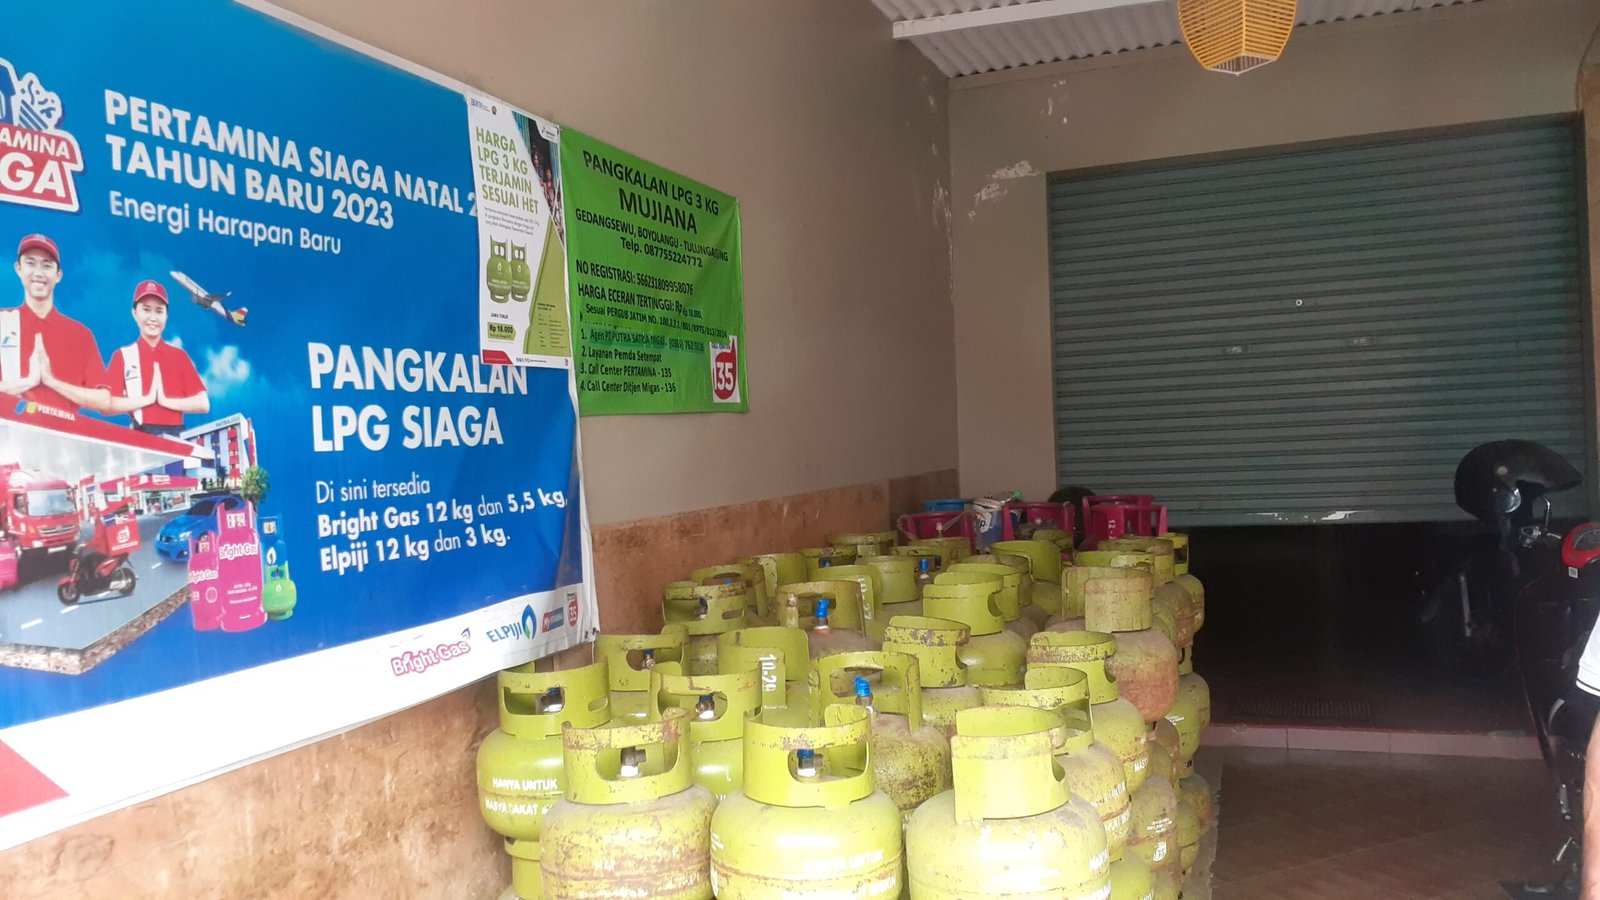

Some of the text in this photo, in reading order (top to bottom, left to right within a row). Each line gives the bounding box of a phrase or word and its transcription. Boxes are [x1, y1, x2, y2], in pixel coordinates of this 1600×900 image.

[104, 89, 302, 172] PERTAMINA
[309, 146, 388, 194] SIAGA
[394, 171, 464, 214] NATAL
[475, 126, 517, 154] HARGA
[477, 146, 528, 175] LPG 3 KG
[105, 133, 394, 230] TAHUN BARU 2023
[479, 164, 532, 195] TERJAMIN
[583, 150, 719, 216] PANGKALAN LPG 3 KG
[482, 184, 539, 214] SESUAI HET
[618, 187, 698, 234] MUJIANA
[109, 190, 341, 255] Energi Harapan Baru
[575, 208, 636, 238] GEDANGSEWU,
[637, 226, 679, 249] BOYOLANGU
[620, 237, 703, 268] Telp. 087755224772
[576, 259, 589, 274] NO
[590, 263, 636, 284] REGISTRASI:
[578, 282, 607, 301] HARGA
[608, 288, 636, 306] ECERAN
[636, 293, 675, 312] TERTINGGI:
[585, 303, 606, 316] Sesuai
[606, 306, 629, 320] PERGUB
[629, 311, 647, 323] JATIM
[580, 329, 587, 340] 1.
[307, 341, 528, 396] PANGKALAN
[580, 362, 587, 374] 3.
[588, 363, 599, 375] Call
[600, 365, 623, 376] Center
[623, 366, 657, 378] PERTAMINA
[661, 368, 672, 378] 135
[588, 348, 613, 361] Layanan
[614, 349, 636, 361] Pemda
[637, 350, 662, 363] Setempat
[587, 381, 601, 392] Call
[602, 382, 622, 393] Center
[623, 382, 641, 397] Ditjen
[642, 383, 660, 395] Migas
[665, 382, 677, 393] 136
[312, 404, 504, 452] LPG SIAGA
[315, 471, 431, 504] Di sini tersedia
[317, 508, 378, 540] Bright
[384, 506, 420, 529] Gas
[426, 501, 447, 523] 12
[452, 498, 473, 524] kg
[478, 494, 503, 517] dan
[507, 491, 535, 515] 5,5
[320, 523, 511, 575] Elpiji 12 kg dan 3 kg.
[486, 620, 522, 643] ELPIJI
[391, 640, 471, 676] Bright Gas
[492, 777, 558, 791] HANYA UNTUK
